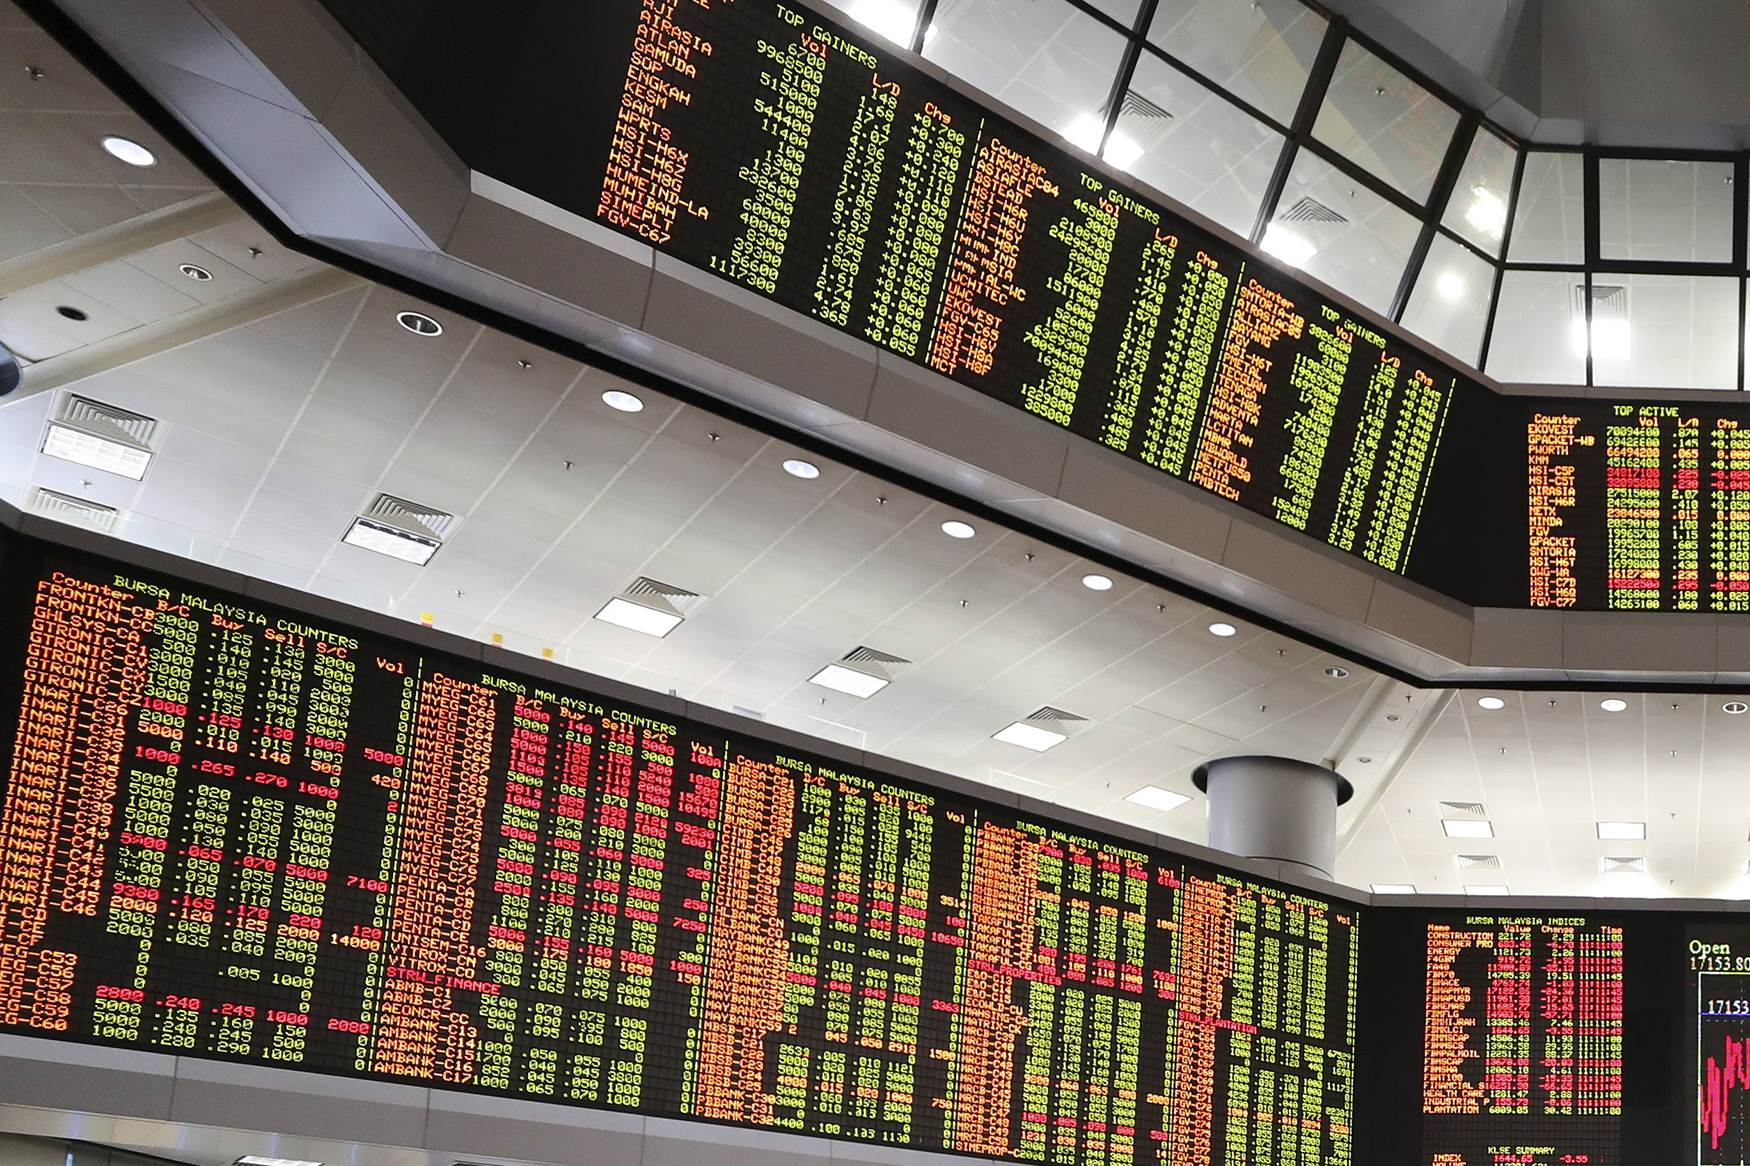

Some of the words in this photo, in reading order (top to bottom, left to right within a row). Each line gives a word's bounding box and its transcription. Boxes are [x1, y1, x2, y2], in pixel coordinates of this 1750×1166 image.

[639, 10, 713, 56] AIRASIA
[775, 4, 804, 27] TOP
[812, 26, 877, 70] GAINERS
[636, 25, 690, 60] ATLAN
[801, 33, 828, 57] Vol
[633, 37, 697, 78] GAMUDA
[872, 73, 901, 97] L/D
[603, 177, 677, 219] MUHIBAH
[600, 190, 674, 231] SIMEPLT
[596, 205, 671, 244] FGV-C67
[1613, 405, 1633, 417] TOP
[1639, 406, 1679, 417] ACTIVE
[1534, 414, 1581, 426] Counter
[1528, 445, 1568, 456] PWORTH
[1528, 486, 1576, 497] AIRASIA
[1607, 488, 1660, 499] 27515000
[1671, 489, 1699, 500] 2.07
[38, 580, 155, 620] FRONTKN-CB
[51, 571, 134, 601] Counter
[157, 599, 190, 618] B/C
[211, 615, 244, 631] Buy
[264, 629, 305, 648] Sell
[316, 642, 348, 659] S/C
[113, 574, 170, 599] BURSA
[181, 593, 267, 627] MALAYSIA
[277, 620, 359, 650] COUNTERS
[34, 606, 141, 642] GHLSYS-CA
[1427, 924, 1450, 932] Name
[1503, 925, 1531, 933] Value
[1541, 925, 1575, 934] Change
[1601, 926, 1623, 934] Time
[1466, 917, 1494, 925] BURSA
[1498, 917, 1543, 926] MALAYSIA
[1548, 917, 1585, 926] INDICES
[1427, 932, 1494, 940] CONSTRUCTION
[1498, 932, 1531, 941] 221.72
[1551, 933, 1574, 941] 2.29
[1579, 933, 1623, 942] 11:11:00
[1427, 940, 1472, 948] CONSUMER
[1476, 940, 1494, 948] PRO
[1689, 940, 1731, 957] Open
[1426, 971, 1455, 979] FBM70
[1487, 972, 1531, 980] 14705.39
[1546, 972, 1574, 980] 19.51
[1579, 972, 1623, 981] 11:11:45
[1424, 1050, 1480, 1058] FBMPALMOIL
[1485, 1050, 1529, 1058] 12251.35
[1578, 1051, 1622, 1059] 11:11:45
[1423, 1106, 1480, 1114] PLANTATION
[1489, 1106, 1529, 1115] 6809.05
[1544, 1106, 1572, 1115] 30.42
[1577, 1107, 1622, 1116] 11:11:00
[1433, 1154, 1462, 1162] INDEX
[1493, 1154, 1533, 1162] 1644.65
[1559, 1155, 1589, 1163] -3.55
[1488, 1146, 1511, 1155] KLSE
[1516, 1147, 1555, 1155] SUMMARY
